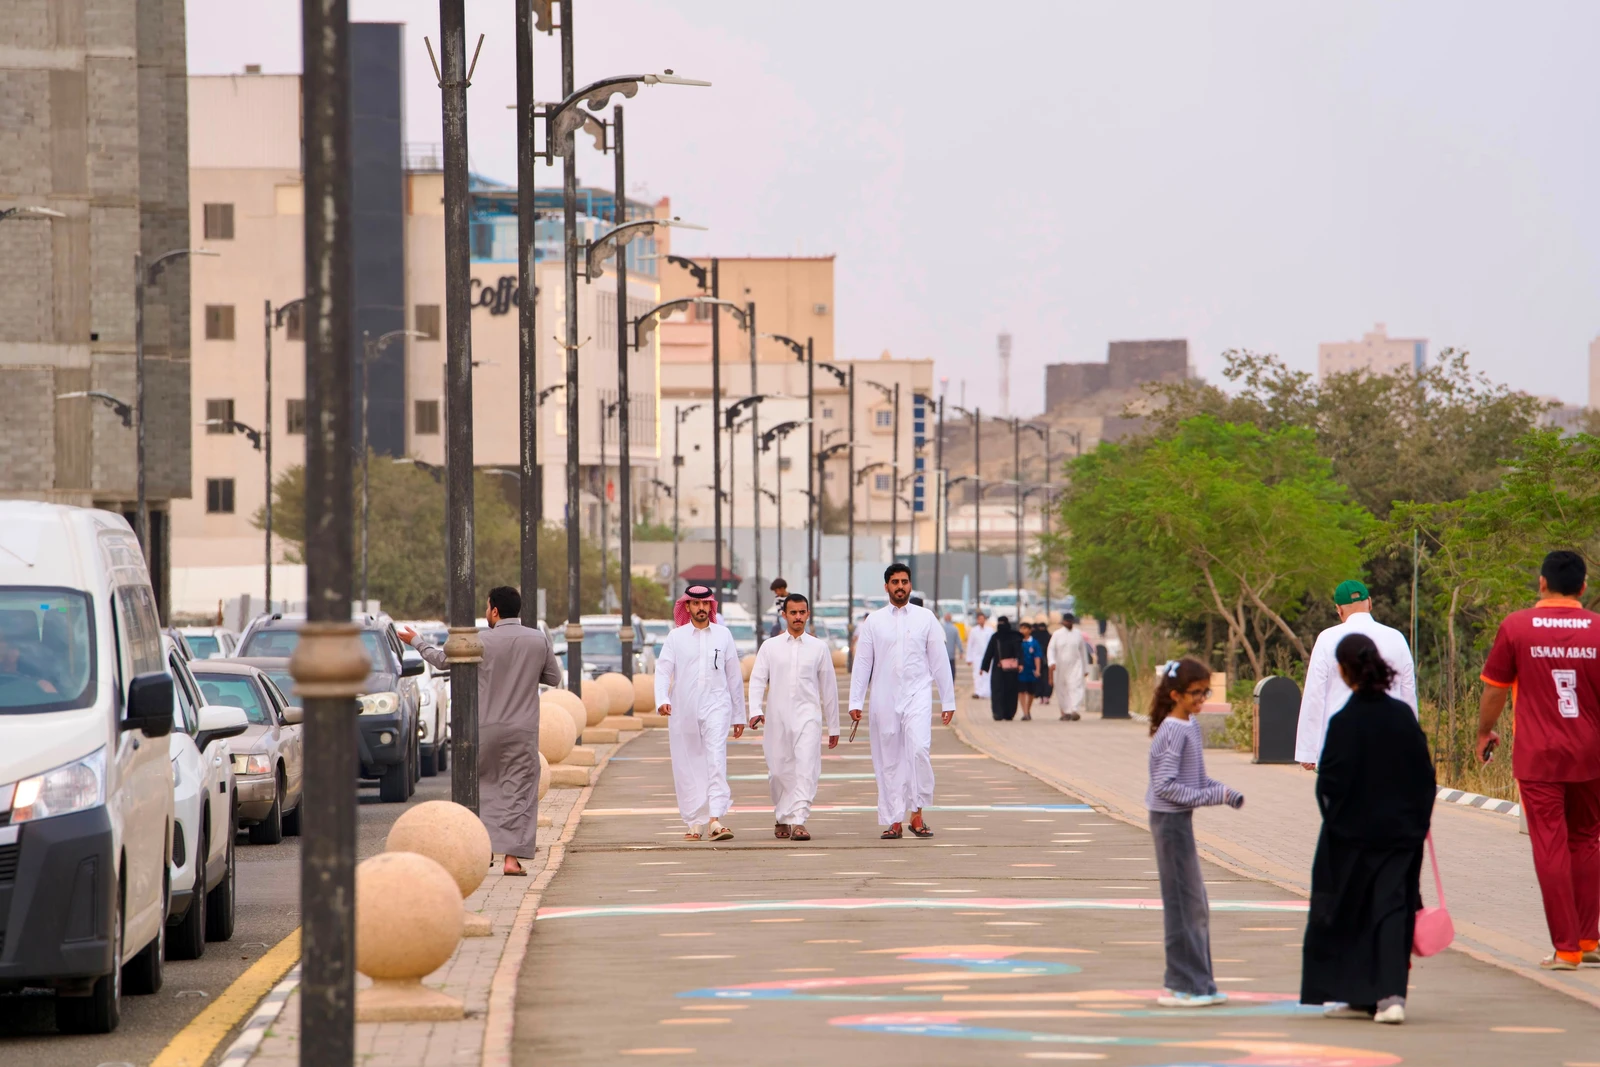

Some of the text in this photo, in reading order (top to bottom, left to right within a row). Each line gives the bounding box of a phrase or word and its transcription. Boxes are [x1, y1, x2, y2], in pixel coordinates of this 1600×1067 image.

[1532, 617, 1592, 629] DUNKIN'
[1530, 645, 1597, 659] USMAN ABASI
[1551, 669, 1579, 718] 5
